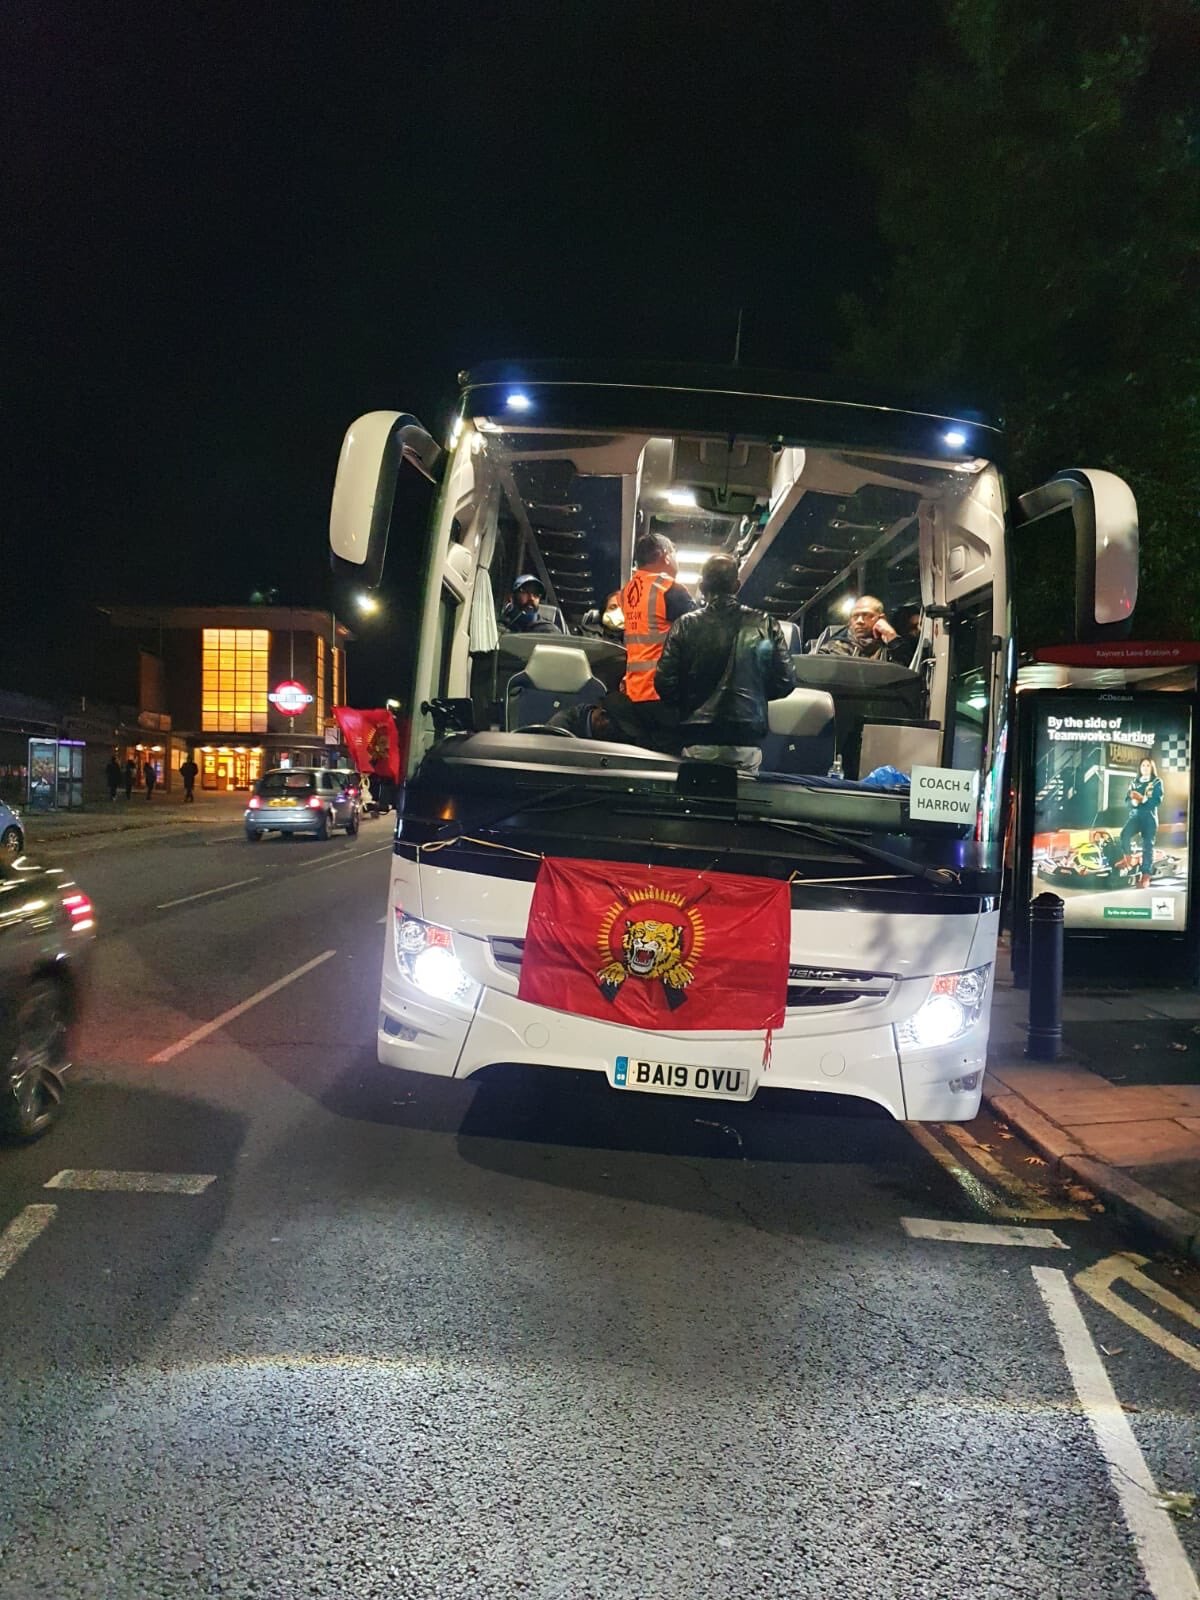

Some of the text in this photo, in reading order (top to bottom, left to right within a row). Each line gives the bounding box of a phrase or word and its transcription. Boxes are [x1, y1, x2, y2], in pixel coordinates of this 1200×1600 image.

[1047, 716, 1122, 729] By the side of
[1047, 729, 1155, 745] Teamworks Karting
[919, 777, 970, 792] COACH 4
[917, 797, 971, 813] HARROW
[636, 1062, 741, 1092] BA19 OVU
